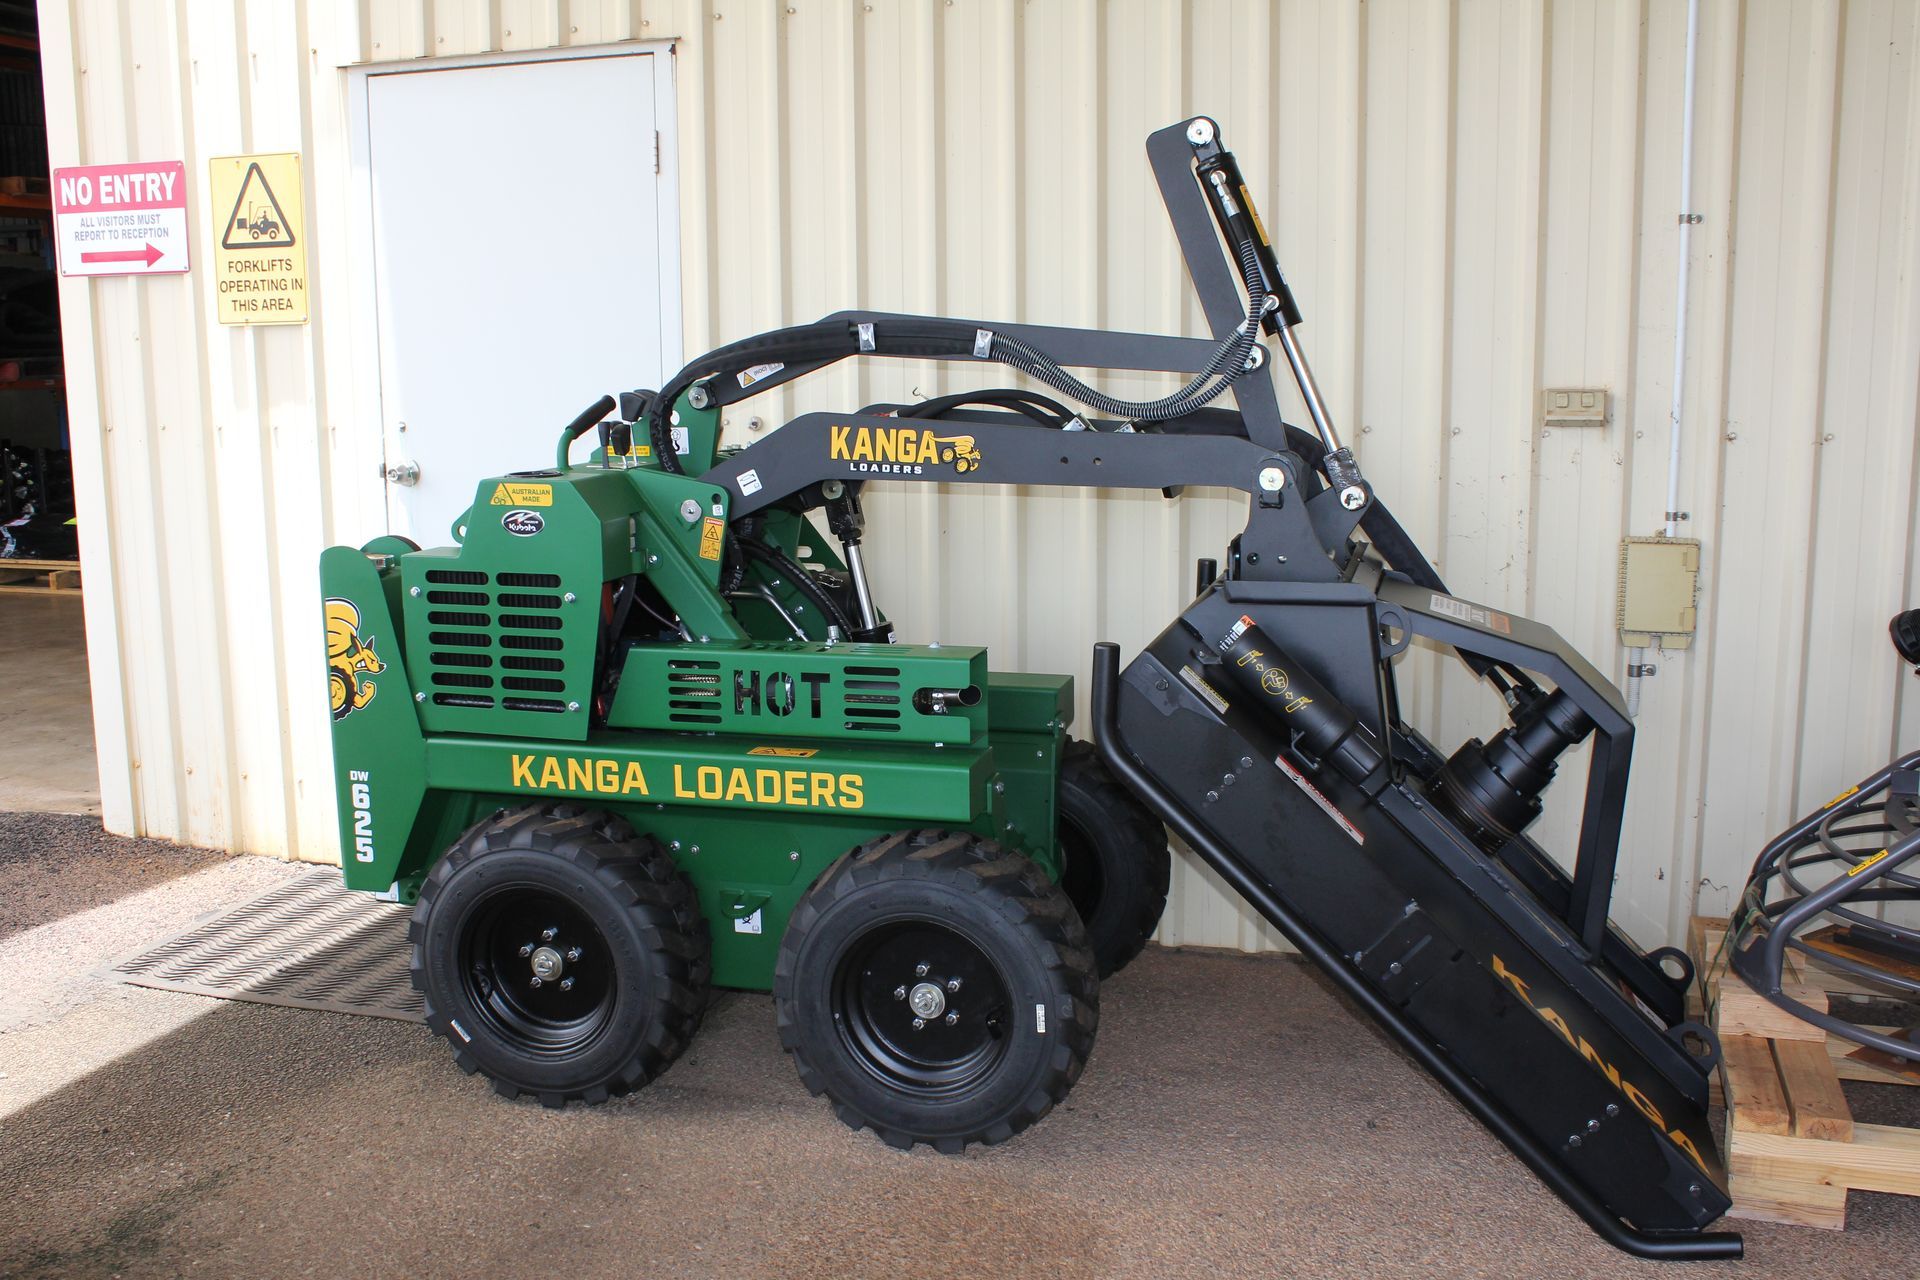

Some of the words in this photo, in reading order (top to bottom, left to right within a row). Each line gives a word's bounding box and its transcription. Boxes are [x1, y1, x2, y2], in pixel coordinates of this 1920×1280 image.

[60, 176, 93, 207] NO
[100, 171, 177, 204] ENTRY
[80, 217, 95, 228] ALL
[97, 215, 135, 227] VISITORS
[137, 213, 161, 225] MUST
[74, 230, 107, 242] REPORT
[109, 229, 120, 240] TO
[121, 227, 169, 239] RECEPTION
[228, 258, 293, 273] FORKLIFTS
[219, 278, 288, 293] OPERATING
[291, 278, 303, 291] IN
[231, 299, 258, 312] THIS
[262, 298, 293, 311] AREA
[832, 426, 939, 464] KANGA
[850, 463, 922, 474] LOADERS
[509, 523, 537, 531] Kubota
[733, 670, 830, 718] HOT
[350, 770, 368, 781] DW
[511, 754, 649, 795] KANGA
[673, 764, 865, 809] LOADERS
[352, 783, 374, 863] 625
[1492, 953, 1712, 1177] KANGA
